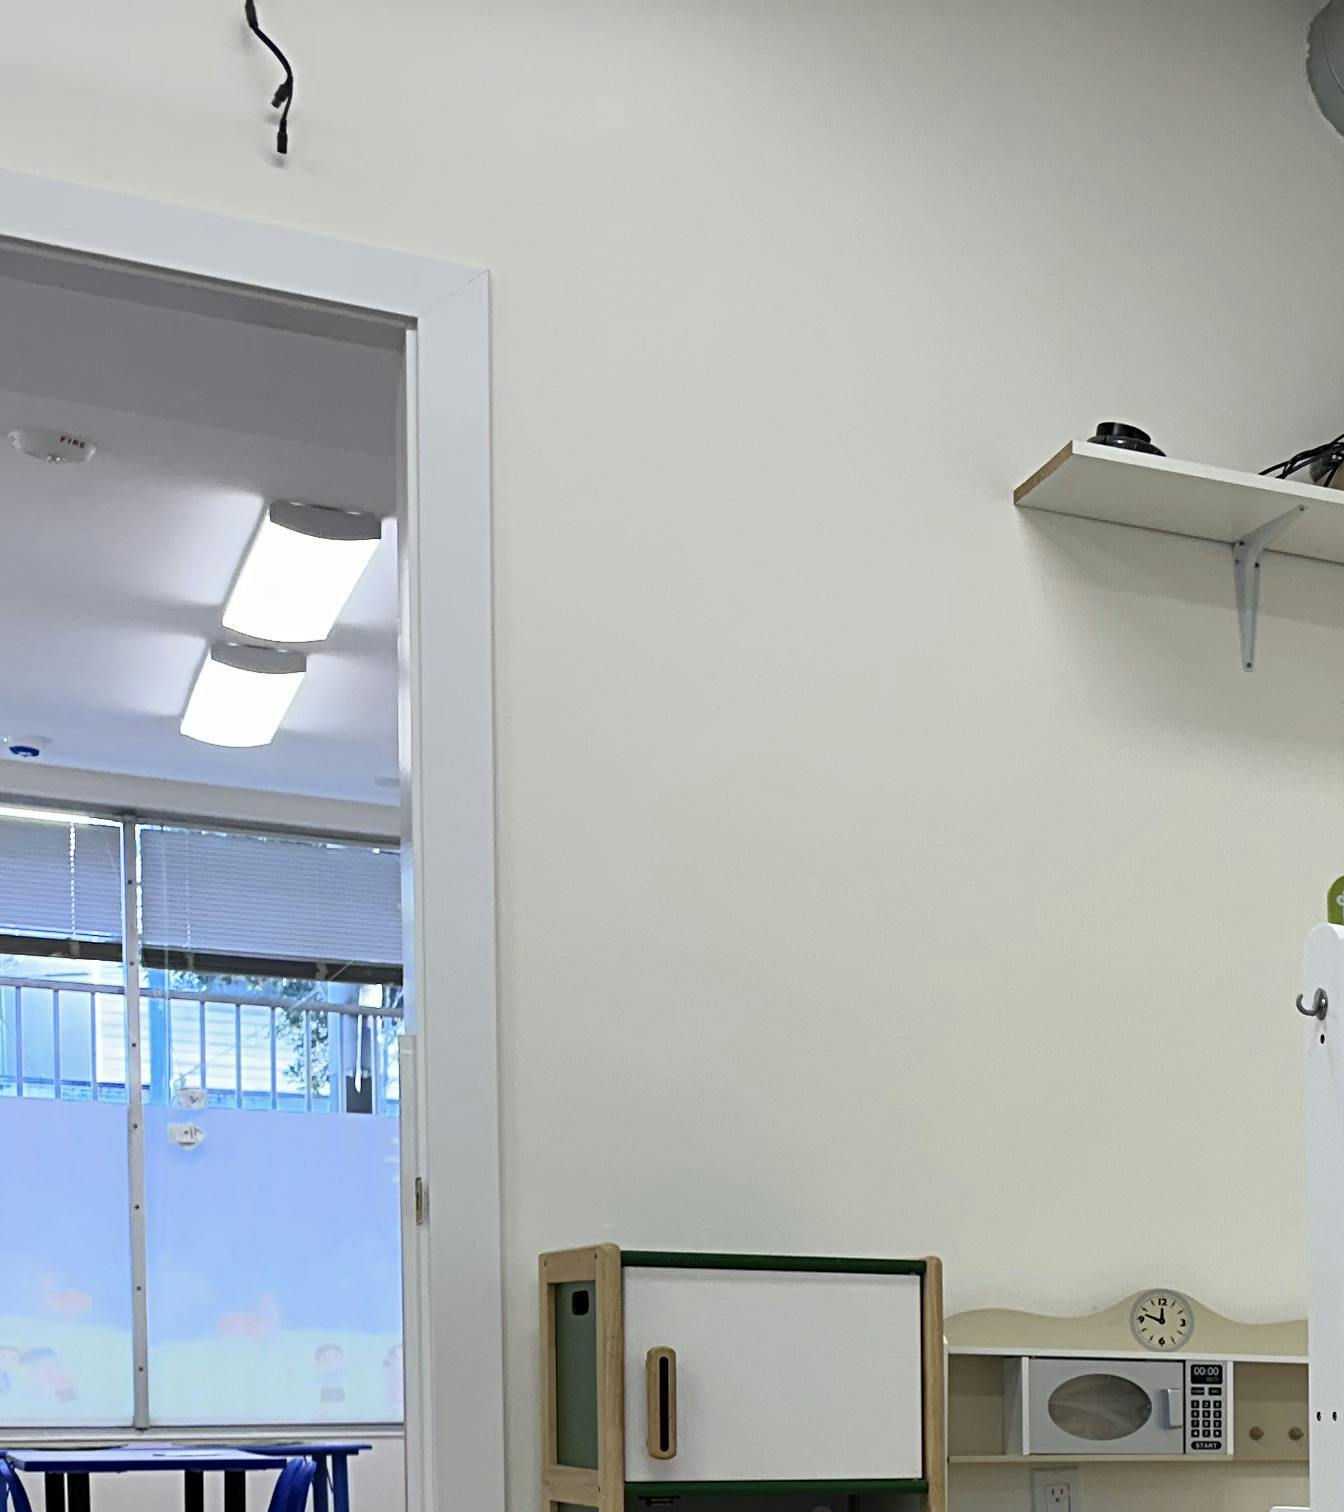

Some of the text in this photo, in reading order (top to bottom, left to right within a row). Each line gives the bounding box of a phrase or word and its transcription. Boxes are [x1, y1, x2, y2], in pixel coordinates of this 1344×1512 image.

[1138, 1315, 1145, 1323] 9
[1180, 1318, 1186, 1327] 3
[1158, 1337, 1165, 1347] 6
